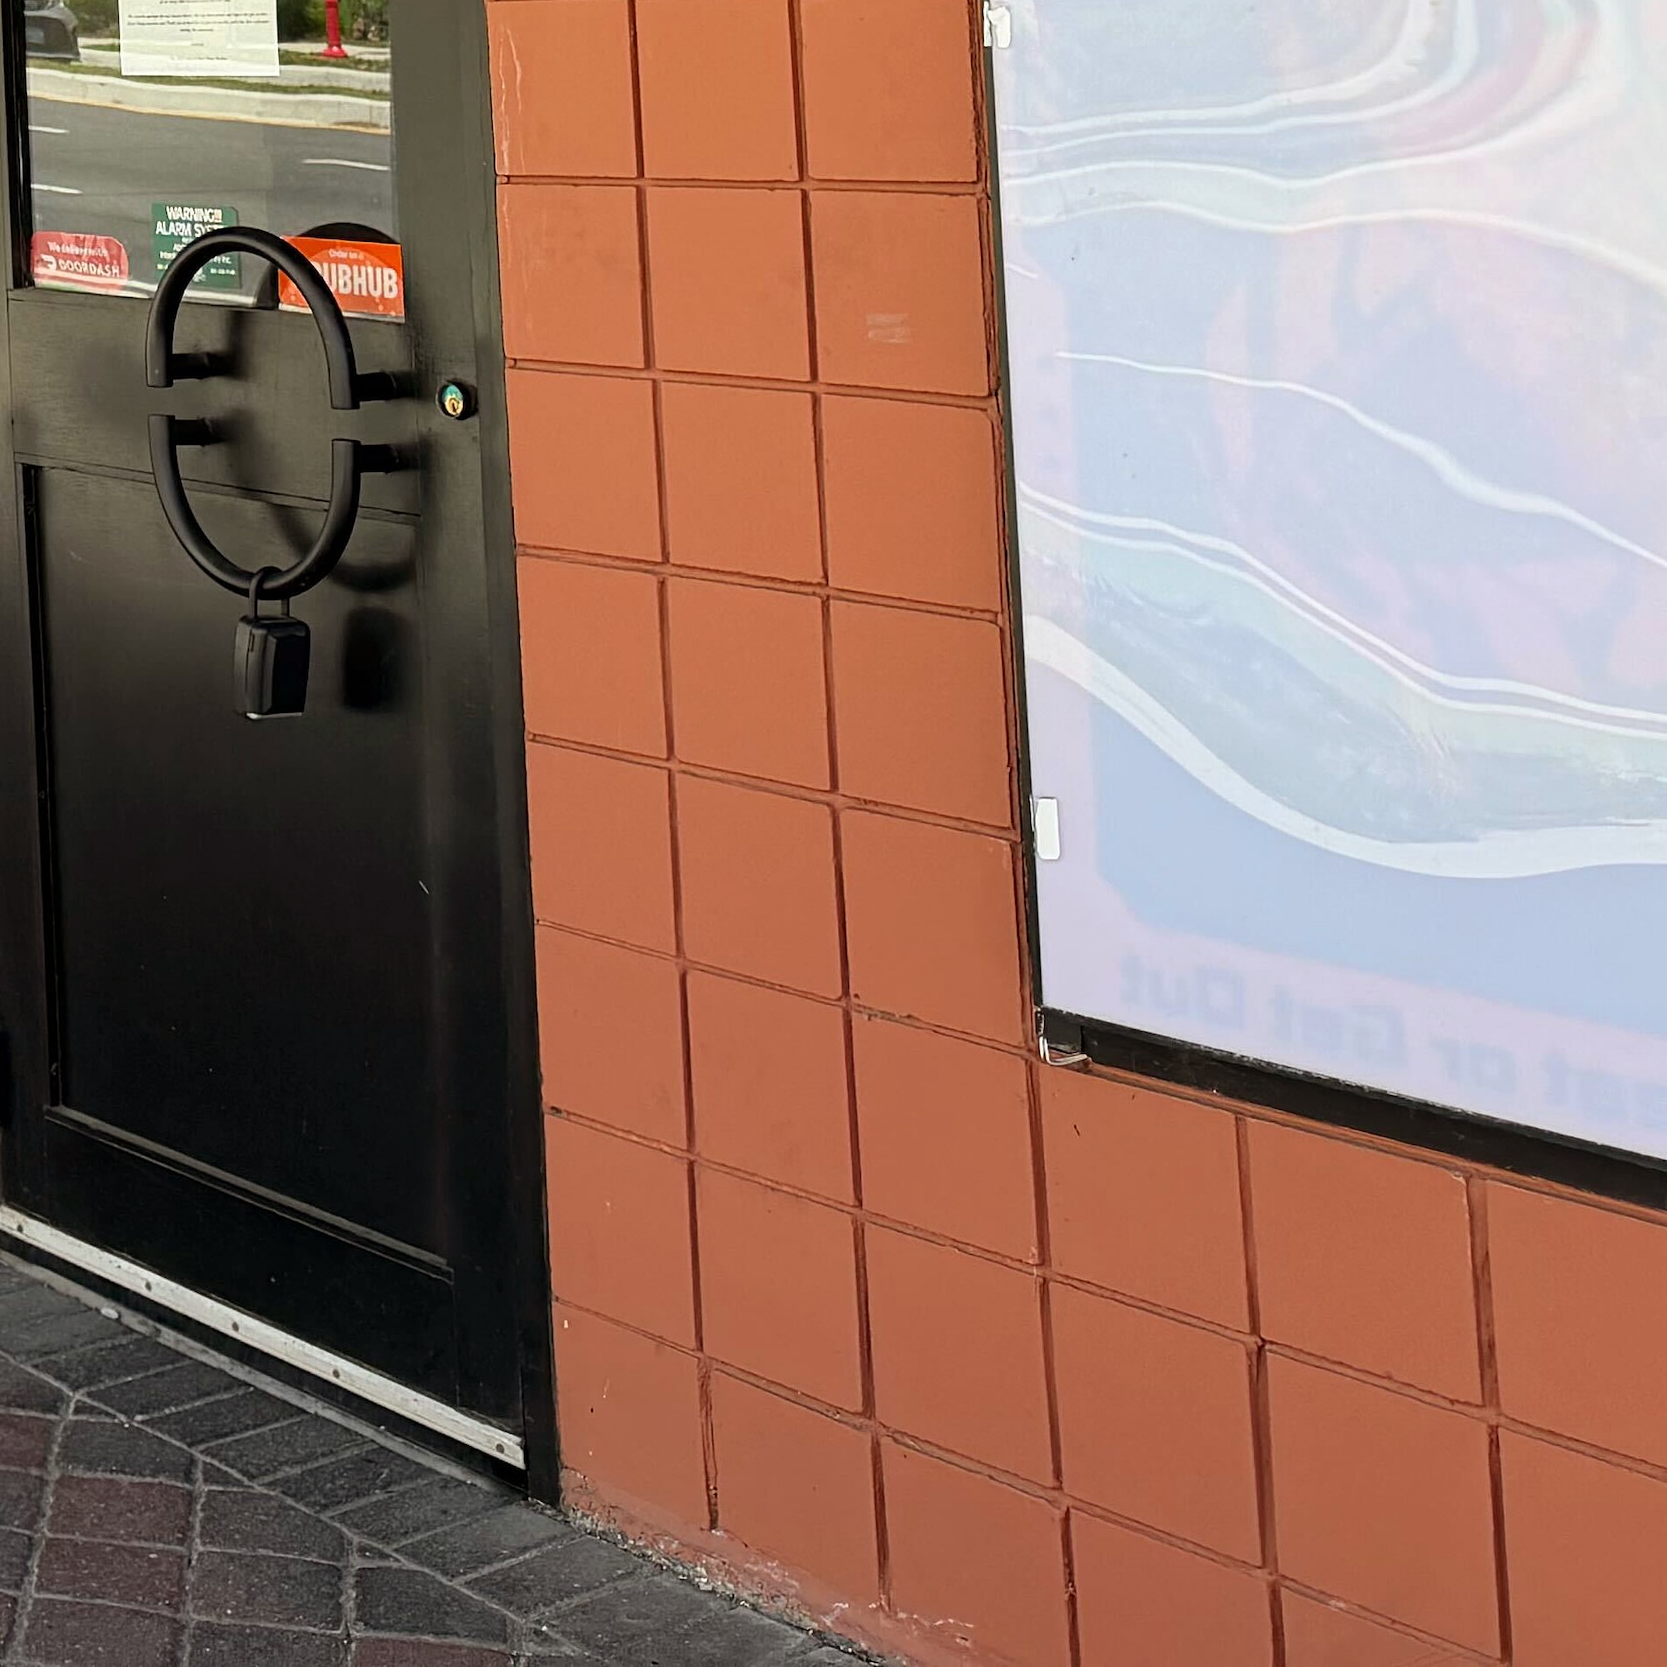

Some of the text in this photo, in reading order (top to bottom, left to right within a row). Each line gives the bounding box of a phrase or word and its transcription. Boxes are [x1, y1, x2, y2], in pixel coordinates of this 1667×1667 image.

[155, 220, 192, 236] ALARM
[47, 241, 61, 253] We
[58, 258, 120, 277] DOORDASH
[312, 260, 398, 299] UBHUB
